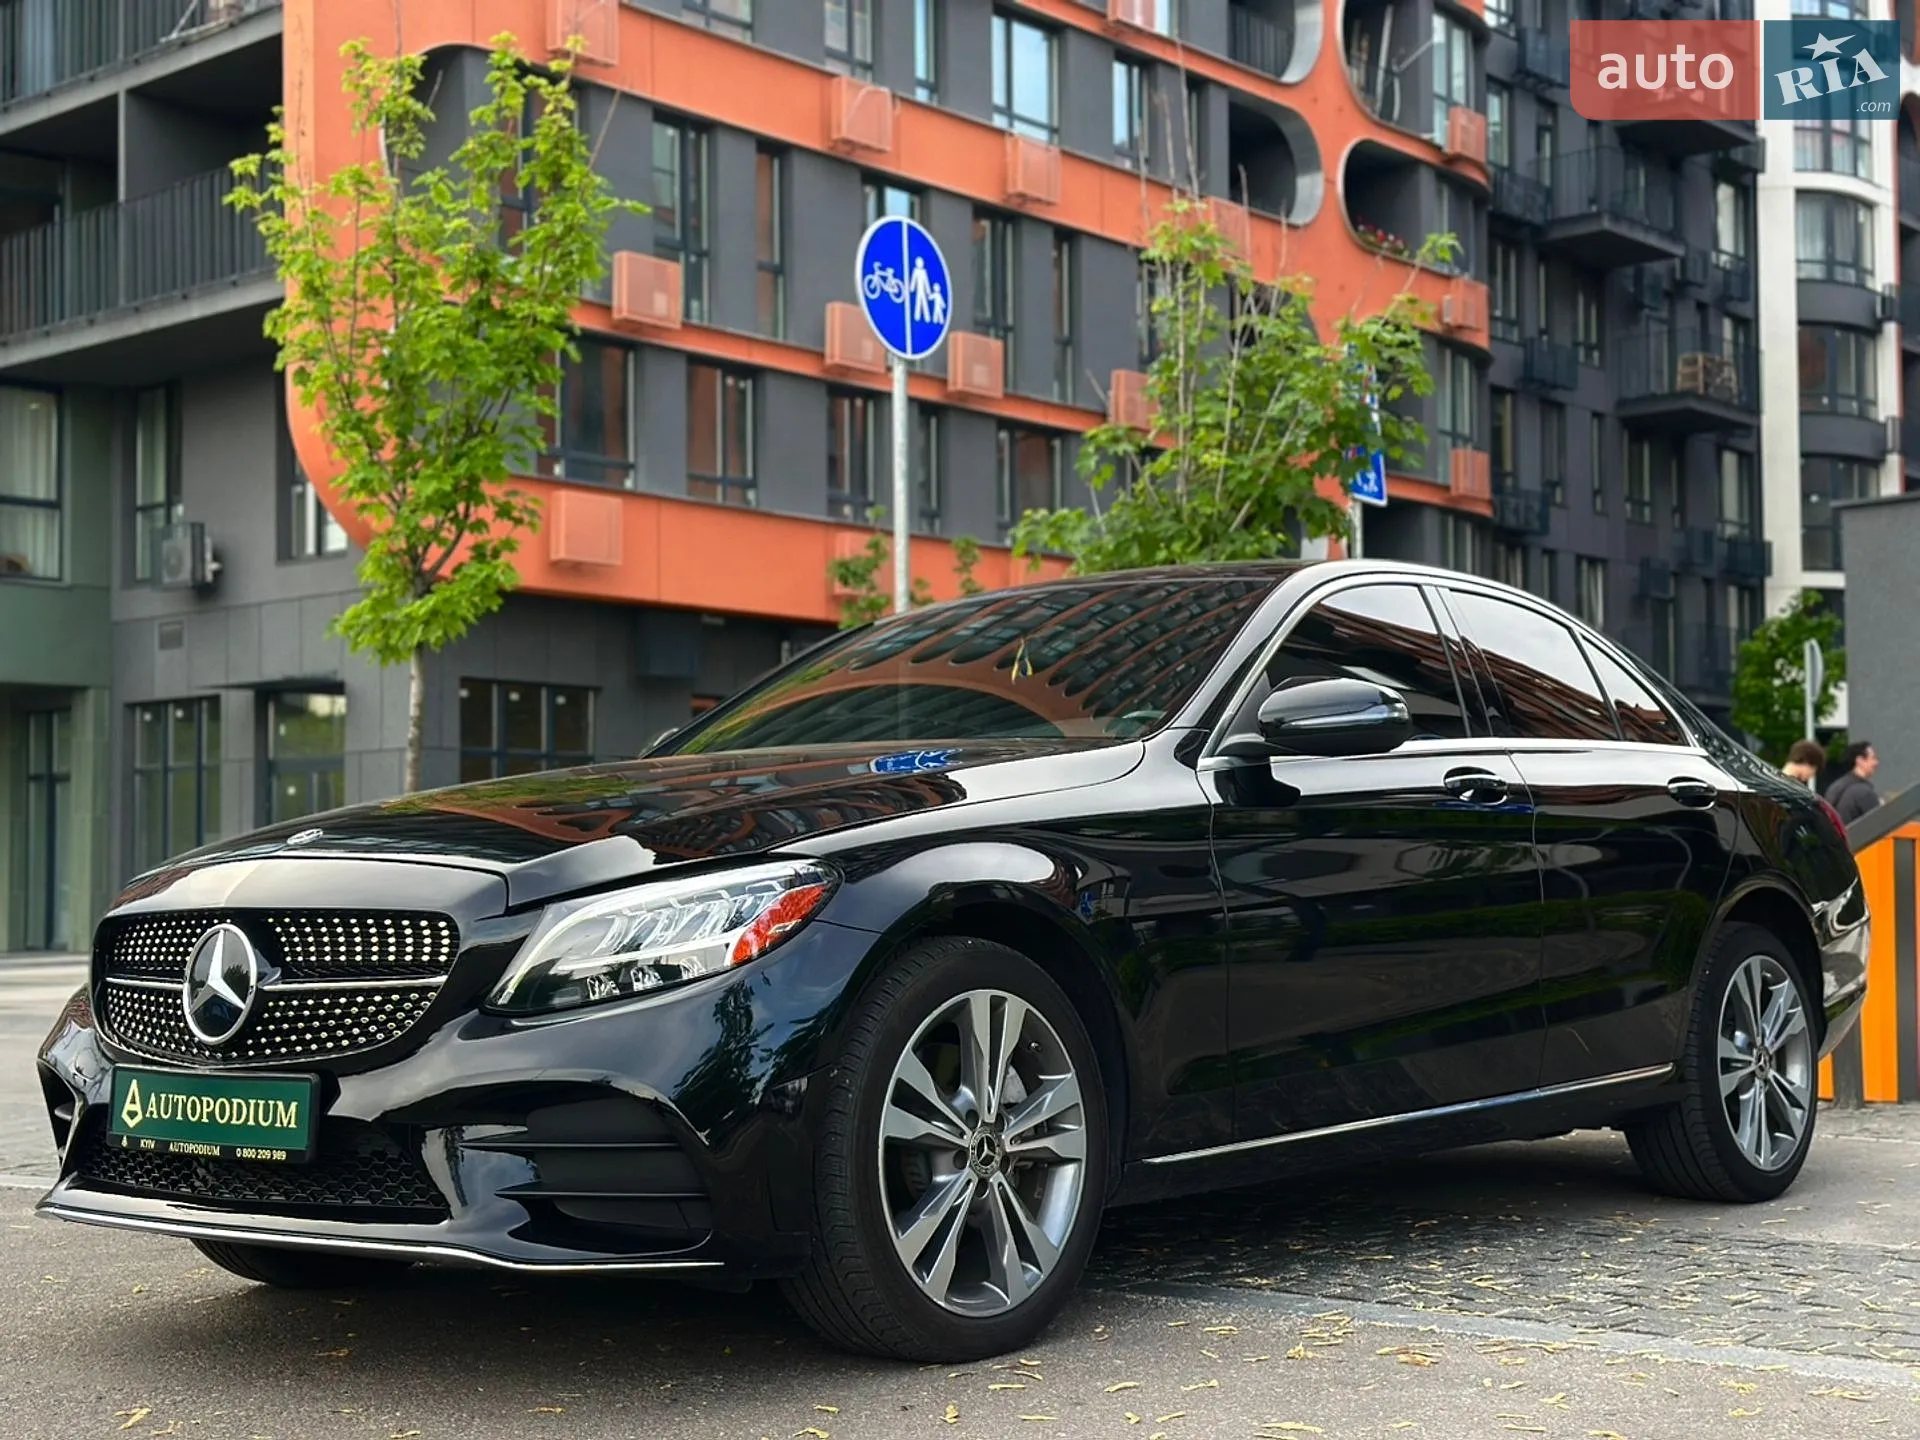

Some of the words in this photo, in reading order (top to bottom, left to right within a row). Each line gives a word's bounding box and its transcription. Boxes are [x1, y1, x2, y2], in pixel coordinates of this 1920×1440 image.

[146, 1092, 298, 1128] AUTOPODIUM
[140, 1138, 155, 1149] KYIV
[169, 1142, 220, 1156] AUTOPODIUM
[242, 1148, 256, 1159] 800
[257, 1149, 271, 1159] 209
